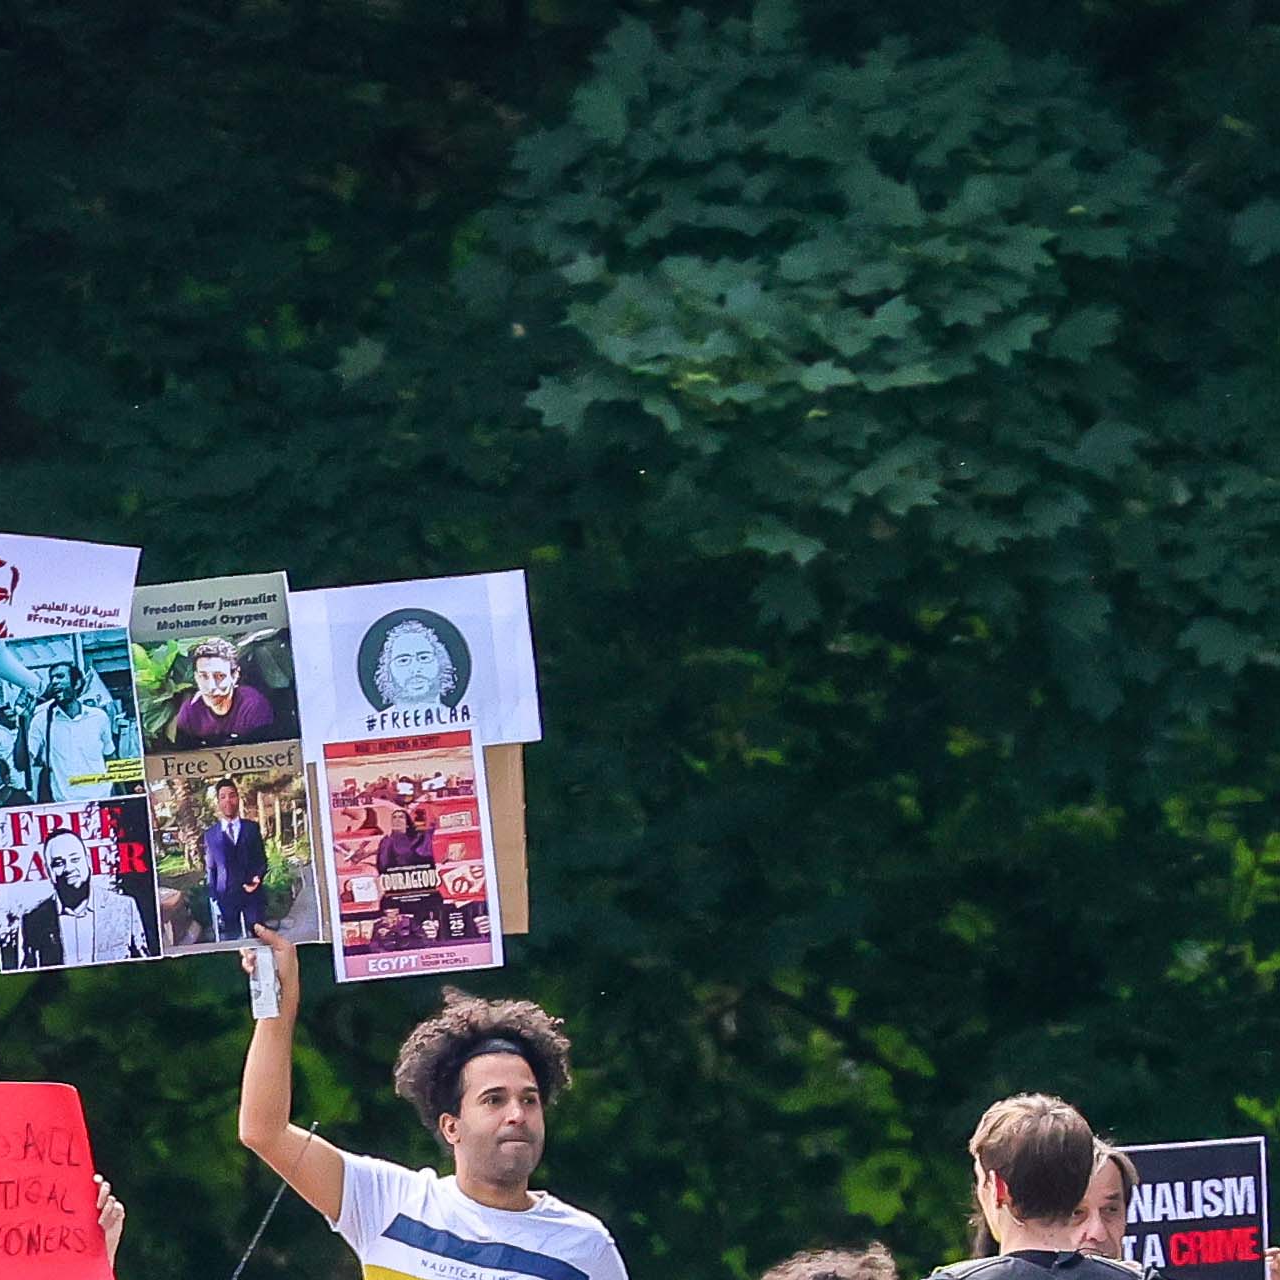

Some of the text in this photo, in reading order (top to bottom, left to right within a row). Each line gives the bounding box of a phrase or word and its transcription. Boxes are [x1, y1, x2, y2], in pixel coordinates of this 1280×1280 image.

[142, 593, 278, 616] Freedom for journalist
[156, 612, 268, 631] Mohamed Oxygen
[365, 704, 471, 731] #FREEALAA
[162, 745, 296, 777] Free Youssef
[7, 806, 126, 847] FREE
[449, 919, 465, 930] 25
[368, 955, 418, 973] EGYPT
[23, 1122, 82, 1168] ALL
[1126, 1175, 1257, 1224] NALISM
[1143, 1233, 1166, 1269] A
[1169, 1227, 1262, 1267] CRIME
[420, 1259, 485, 1280] NAUTICAL
